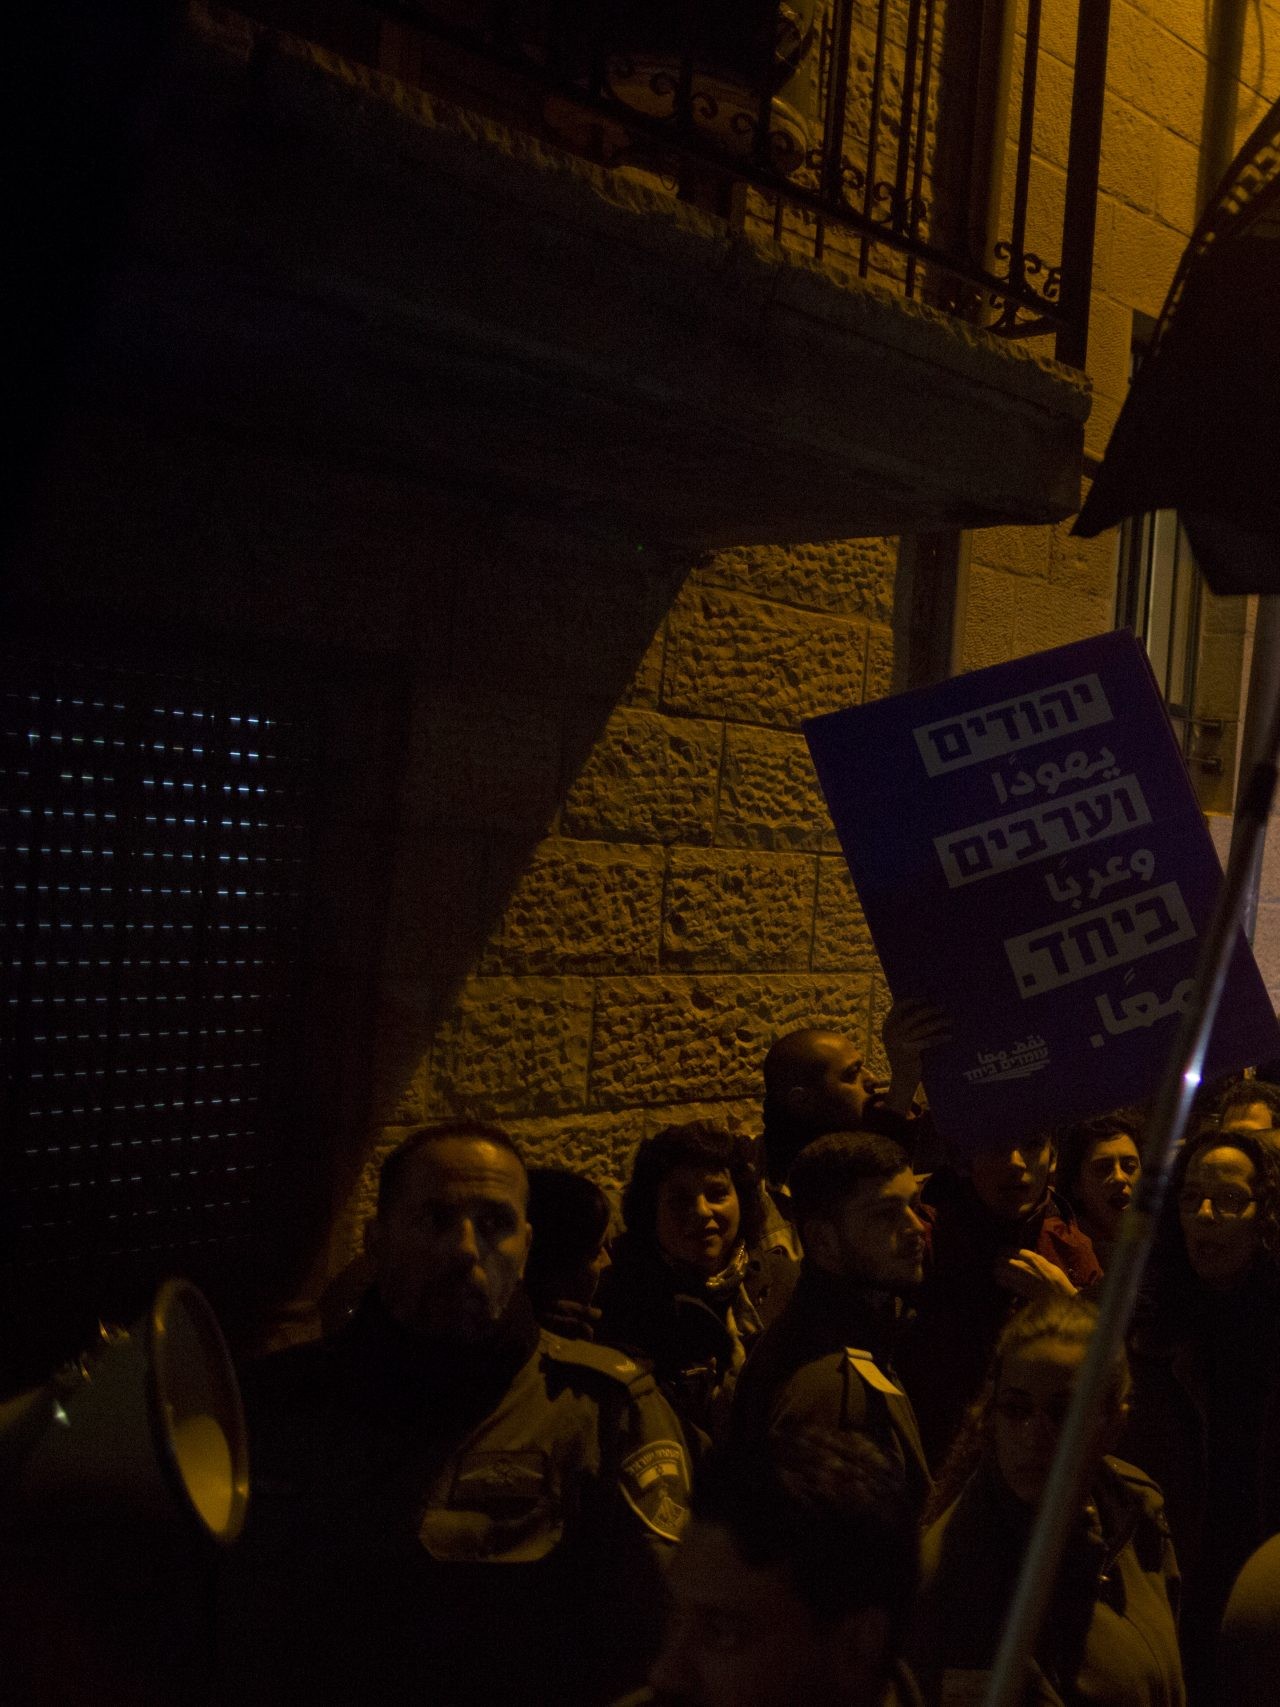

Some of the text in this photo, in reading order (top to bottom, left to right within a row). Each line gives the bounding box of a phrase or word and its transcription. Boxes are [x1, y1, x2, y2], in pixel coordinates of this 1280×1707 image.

[927, 681, 1096, 763] יהודים
[948, 786, 1139, 877] וערבים
[1022, 896, 1179, 988] ביחד.
